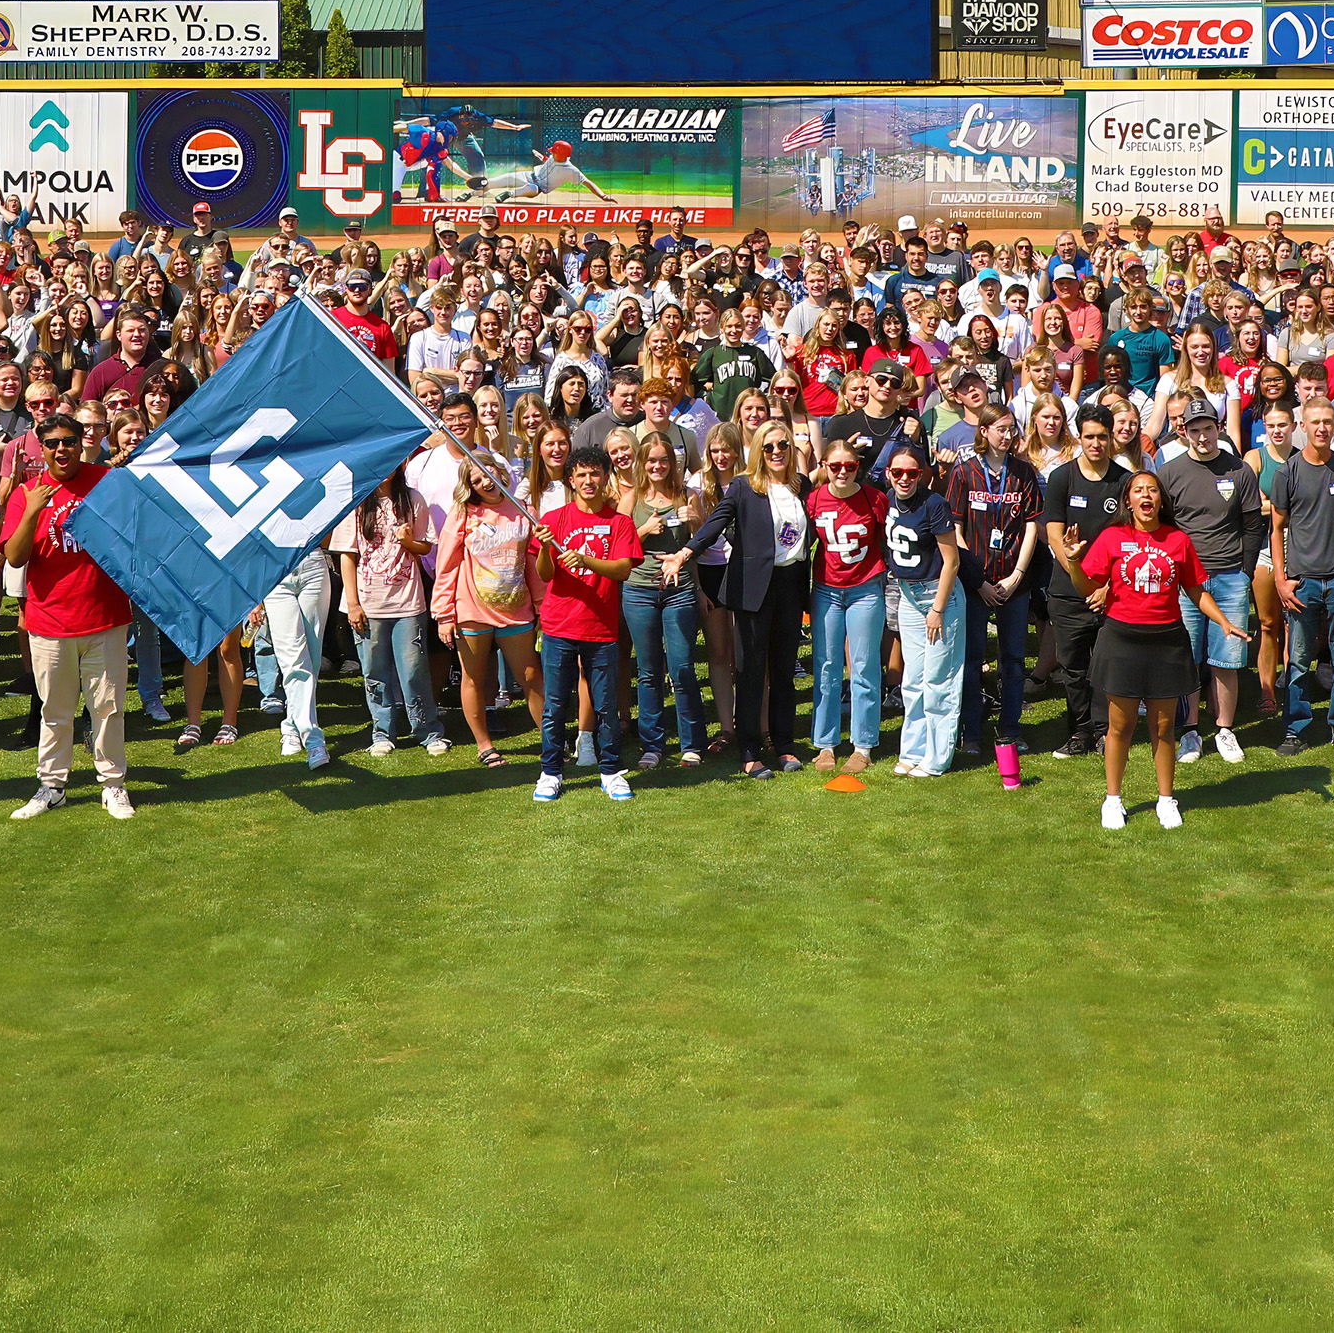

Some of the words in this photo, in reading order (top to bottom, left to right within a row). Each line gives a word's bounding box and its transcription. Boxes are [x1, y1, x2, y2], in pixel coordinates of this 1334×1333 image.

[91, 4, 168, 23] MARK
[174, 4, 209, 23] W.
[962, 2, 1039, 18] DIAMOND
[992, 17, 1038, 32] SHOP
[1092, 15, 1254, 47] COSTCO
[31, 24, 178, 45] SHEPPARD,
[186, 24, 269, 43] D.D.S.
[965, 37, 1005, 45] SINCE
[27, 46, 78, 57] FAMILY
[85, 46, 167, 57] DENTISTRY
[181, 46, 272, 57] 208-743-2792
[1142, 47, 1250, 60] WHOLESALE
[582, 107, 727, 130] GUARDIAN
[949, 103, 1039, 155] Live
[1103, 118, 1201, 150] EyeCare
[581, 133, 629, 143] PLUMBING,
[631, 133, 669, 142] HEATING
[670, 133, 678, 142] &
[698, 133, 716, 143] INC.
[186, 153, 240, 166] PEPSI
[297, 109, 386, 217] LC
[925, 155, 1065, 184] INLAND
[1091, 164, 1125, 177] Mark
[1130, 164, 1197, 181] Eggleston
[1201, 164, 1223, 177] MD
[1095, 180, 1130, 193] Chad
[1134, 180, 1194, 193] Bouterse
[1198, 181, 1219, 193] DO
[941, 193, 989, 205] INLAND
[990, 193, 1049, 205] CELLULAR
[1250, 190, 1304, 204] VALLEY
[29, 202, 90, 225] ANK
[503, 209, 529, 223] NO
[536, 209, 595, 223] PLACE
[603, 209, 643, 223] LIKE
[949, 208, 1042, 220] inlandcellular.com
[717, 360, 736, 384] NEW
[128, 407, 354, 561] LC
[815, 510, 869, 565] LC
